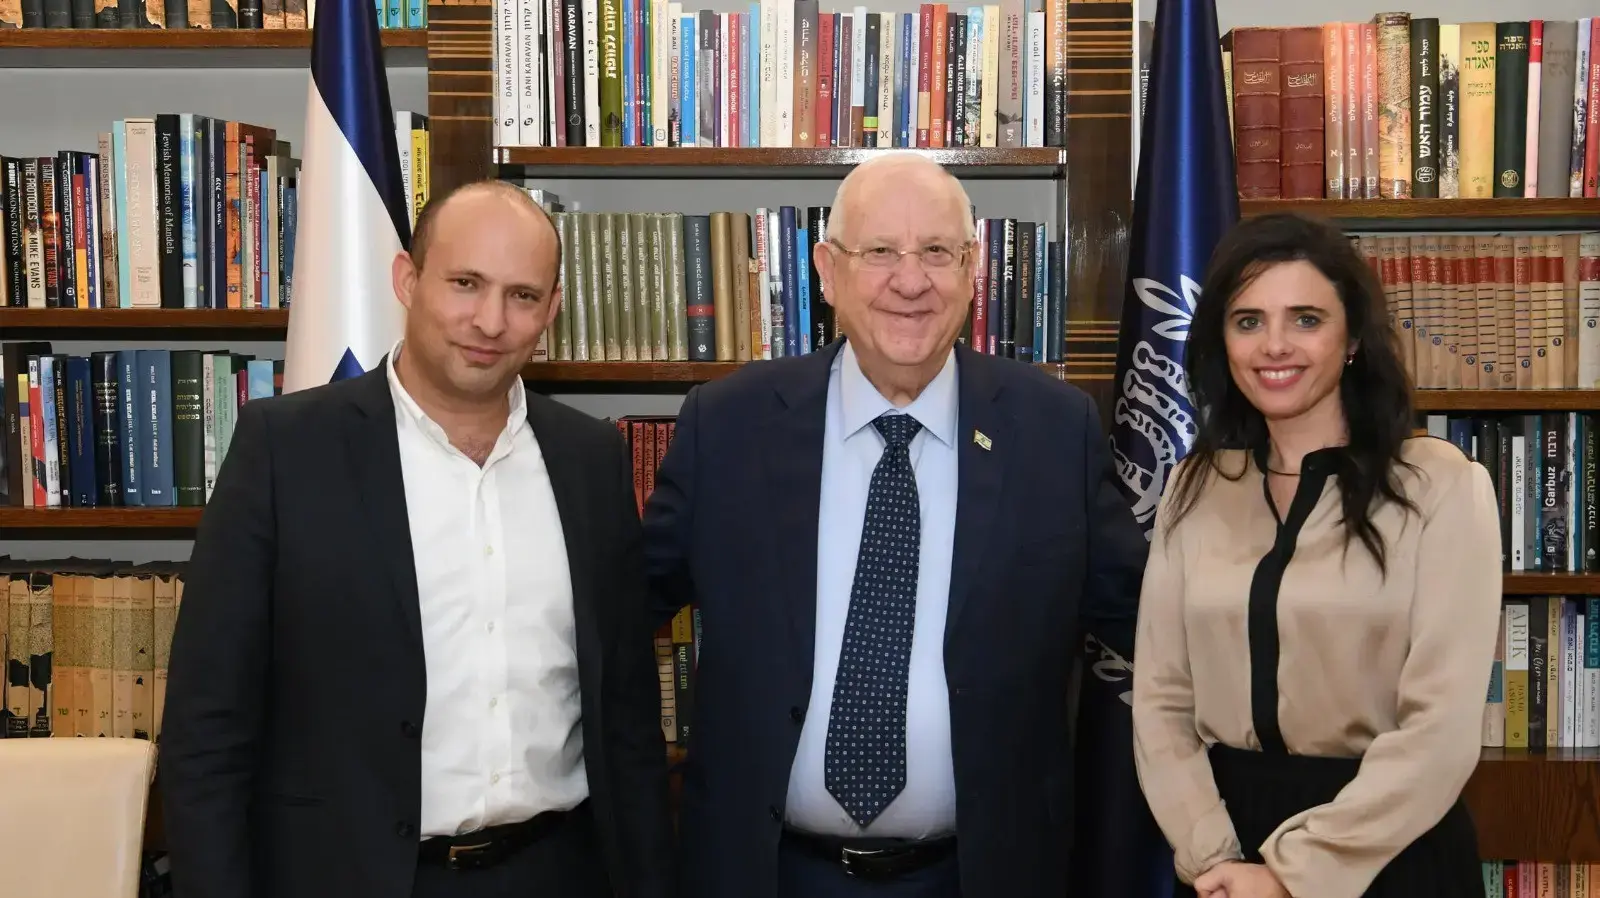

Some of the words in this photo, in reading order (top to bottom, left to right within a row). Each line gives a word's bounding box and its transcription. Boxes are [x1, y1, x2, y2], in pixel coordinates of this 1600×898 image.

[568, 8, 577, 50] KARAVAN
[1503, 35, 1524, 43] ספר
[524, 35, 532, 75] KARAVAN
[1471, 40, 1490, 54] ספר
[1499, 42, 1528, 51] האגדה
[800, 48, 809, 77] שלום
[1053, 38, 1063, 87] הישראלי
[1464, 56, 1495, 71] האגדה
[1328, 94, 1338, 123] ירושלים
[1347, 94, 1357, 122] ירושלים
[1365, 93, 1374, 121] ירושלים
[1419, 84, 1432, 120] עמוד
[162, 132, 172, 161] Jewish
[1330, 149, 1339, 158] א
[1418, 123, 1431, 158] האש
[25, 162, 36, 178] THE
[101, 154, 110, 200] JERUSALEM
[163, 163, 173, 205] Memories
[9, 187, 18, 219] AMONG
[26, 178, 38, 220] PROTOCOLS
[62, 169, 71, 213] Constitutional
[165, 207, 174, 216] of
[11, 220, 20, 256] NATIONS
[29, 237, 39, 258] MIKE
[165, 218, 174, 254] Mandela
[46, 248, 56, 265] MIKE
[30, 261, 40, 289] EVANS
[47, 267, 57, 288] EVANS
[1003, 265, 1013, 281] הלב
[657, 429, 665, 445] אלף
[1547, 430, 1557, 458] גרבוז
[633, 446, 641, 464] לילה
[645, 448, 653, 467] לילה
[1545, 466, 1556, 507] Garbuz
[1587, 463, 1596, 492] צריבה
[1587, 505, 1596, 530] לברנר
[1512, 609, 1526, 659] ARIK
